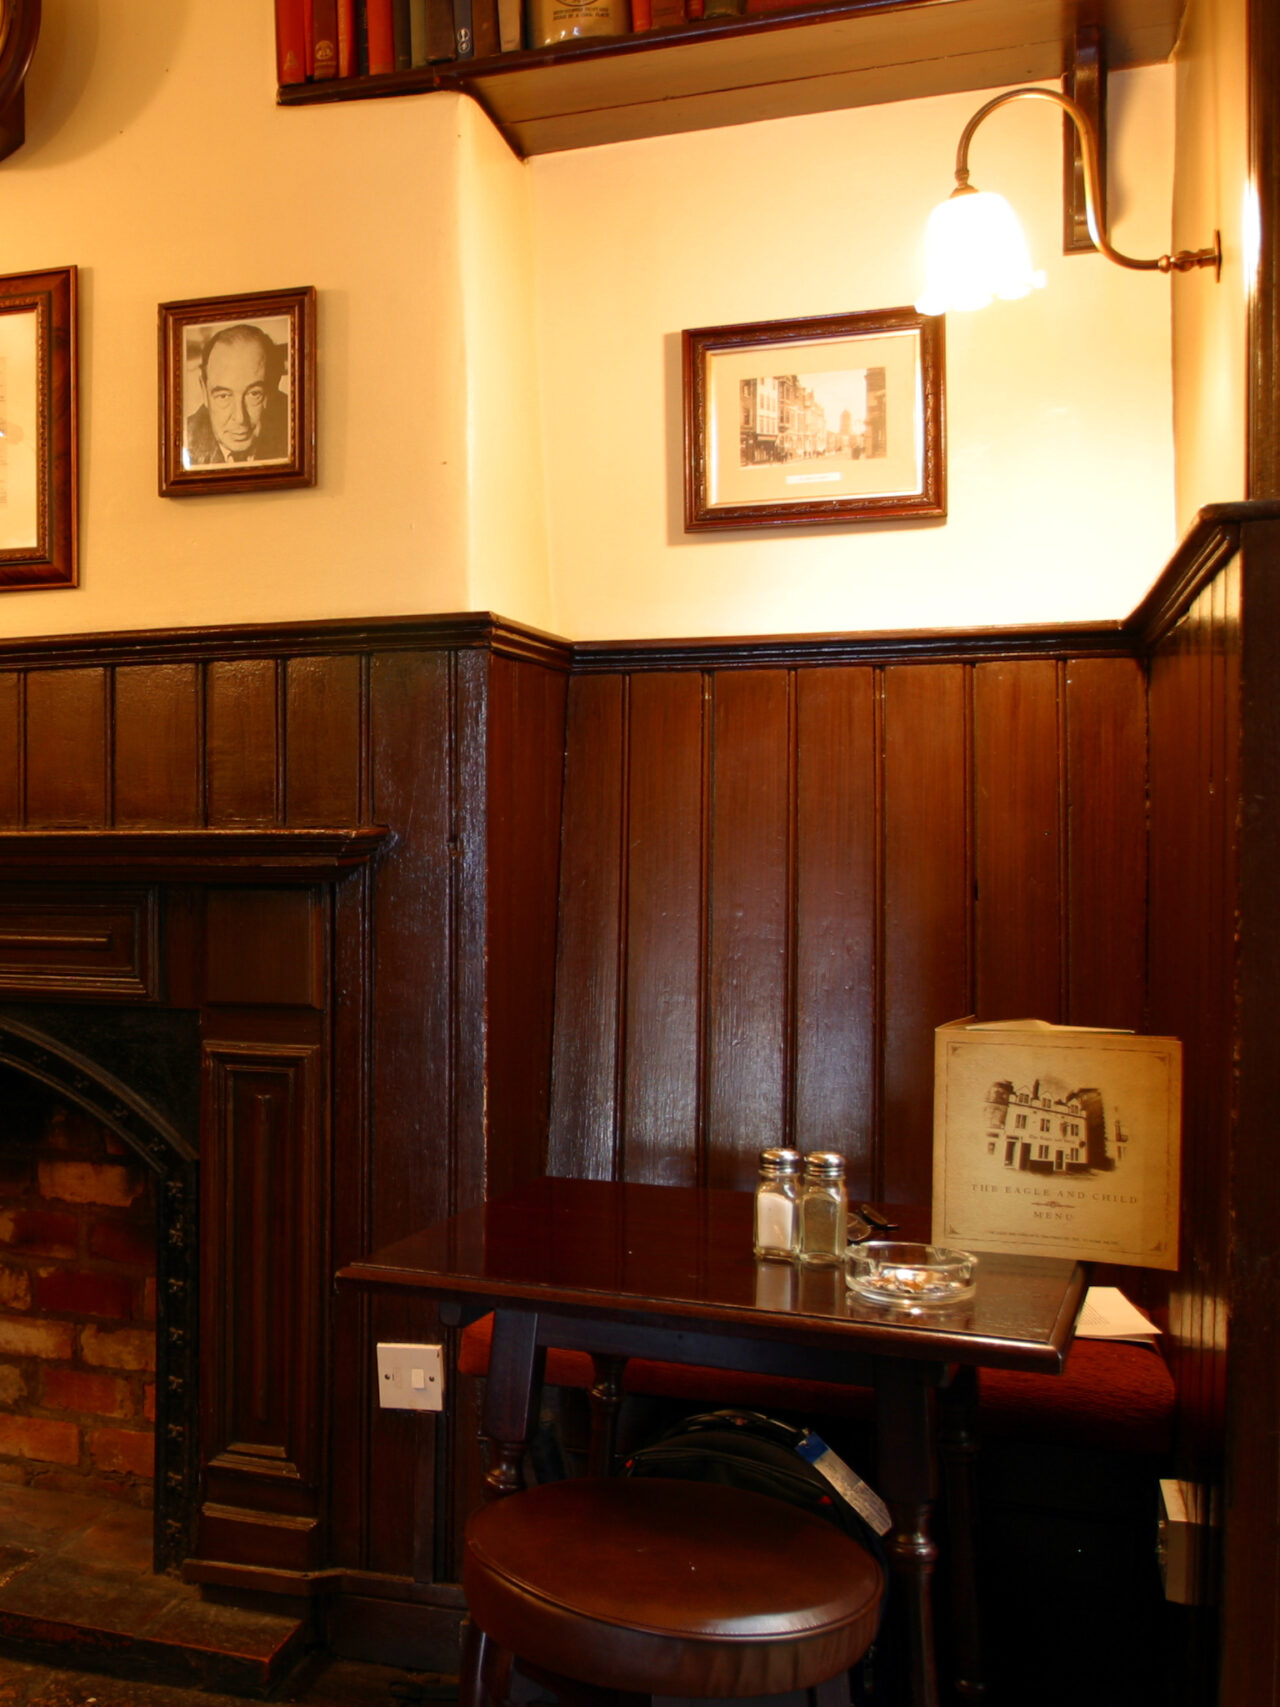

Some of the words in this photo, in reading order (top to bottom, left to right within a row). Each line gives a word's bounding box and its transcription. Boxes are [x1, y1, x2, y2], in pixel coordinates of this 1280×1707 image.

[971, 1183, 998, 1193] THE
[1005, 1186, 1051, 1196] EAGLE
[1057, 1190, 1085, 1200] AND
[1092, 1193, 1137, 1204] CHILD
[1033, 1211, 1073, 1221] MENU
